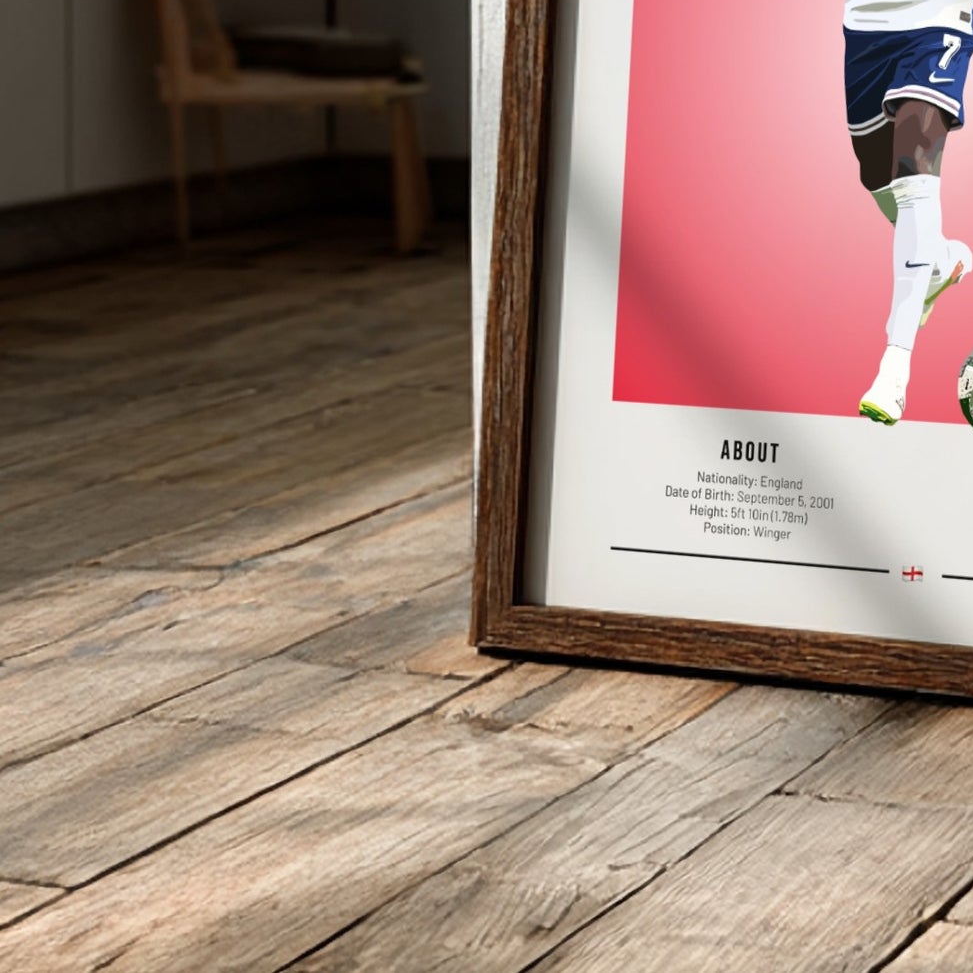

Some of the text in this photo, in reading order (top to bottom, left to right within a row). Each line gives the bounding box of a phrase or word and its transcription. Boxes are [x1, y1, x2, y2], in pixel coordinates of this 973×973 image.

[938, 33, 961, 70] 7
[720, 439, 779, 463] ABOUT
[697, 471, 803, 491] Nationality: England
[665, 485, 834, 510] Date of Birth: September 5, 2001
[689, 504, 728, 519] Height:
[730, 506, 745, 520] 5ft
[703, 521, 792, 541] Position: Winger
